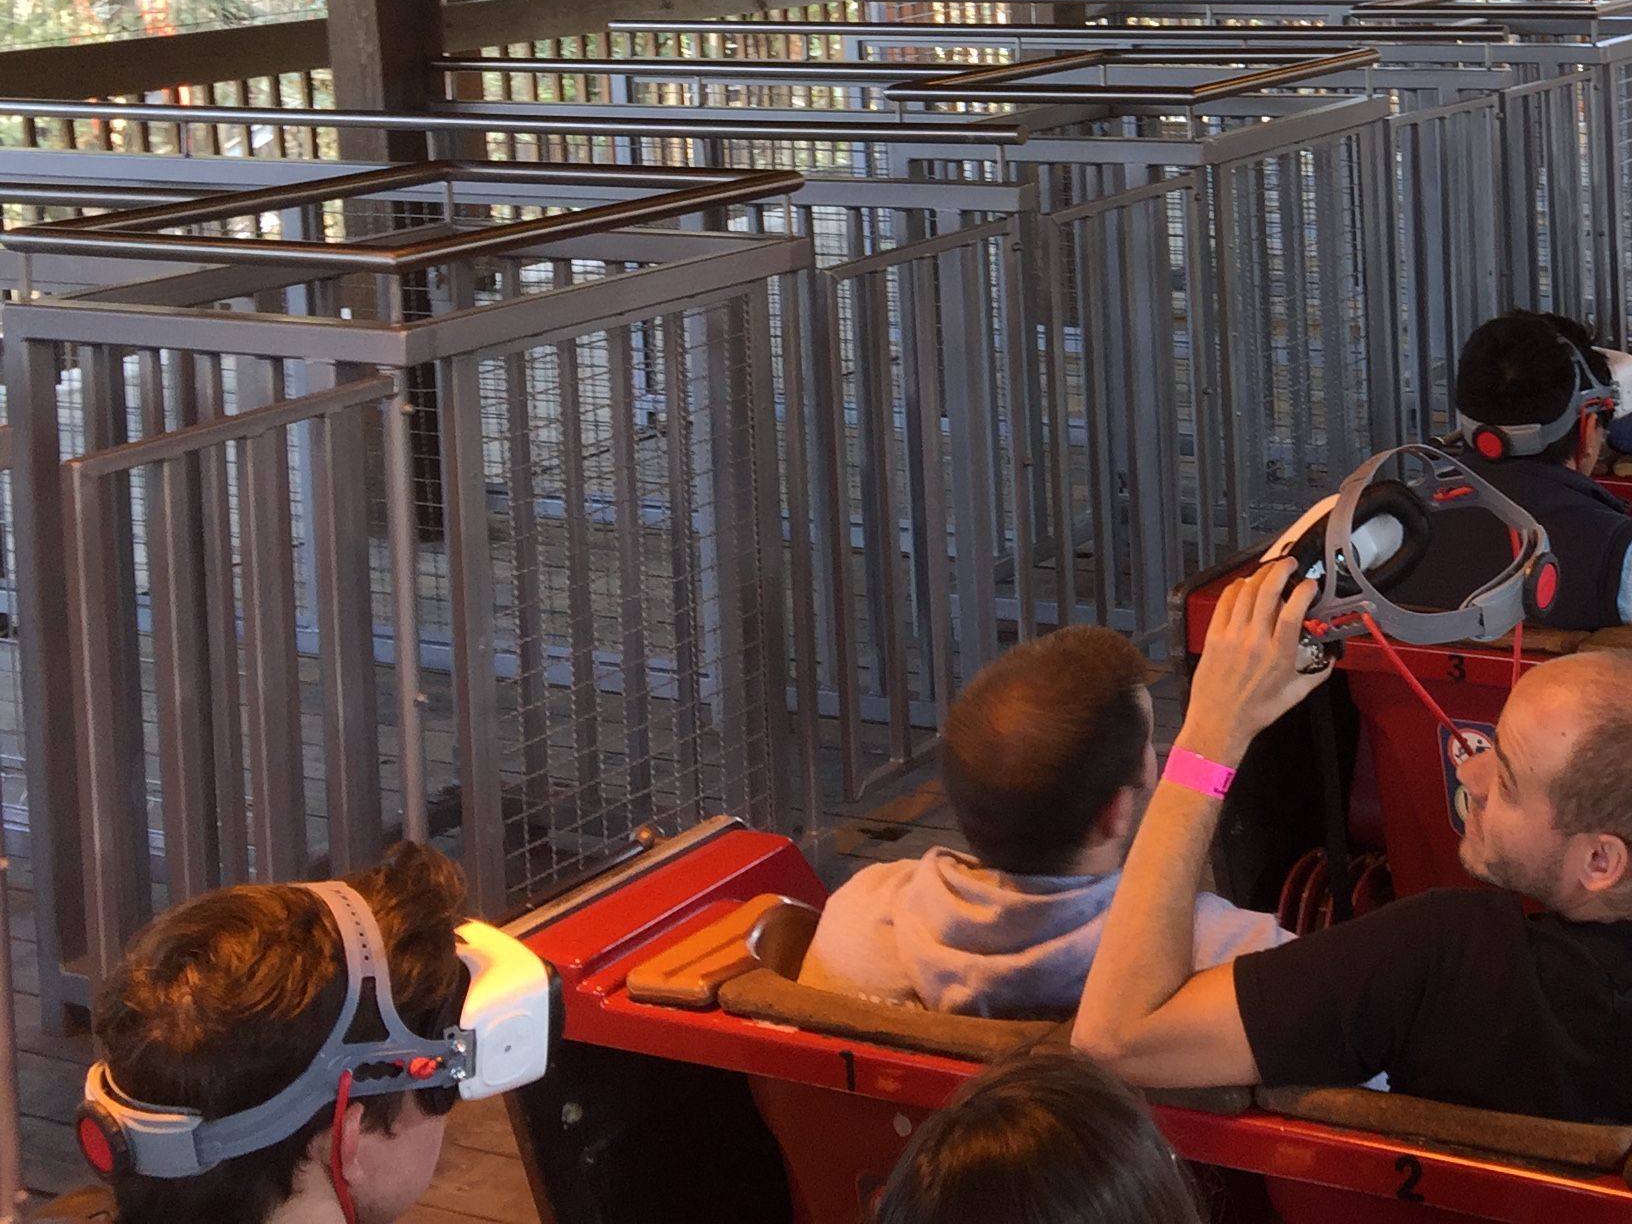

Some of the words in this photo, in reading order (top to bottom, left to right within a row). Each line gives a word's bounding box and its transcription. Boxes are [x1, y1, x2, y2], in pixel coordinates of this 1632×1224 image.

[1447, 654, 1467, 681] 3
[838, 1049, 857, 1091] 1
[1394, 1154, 1426, 1203] 2
